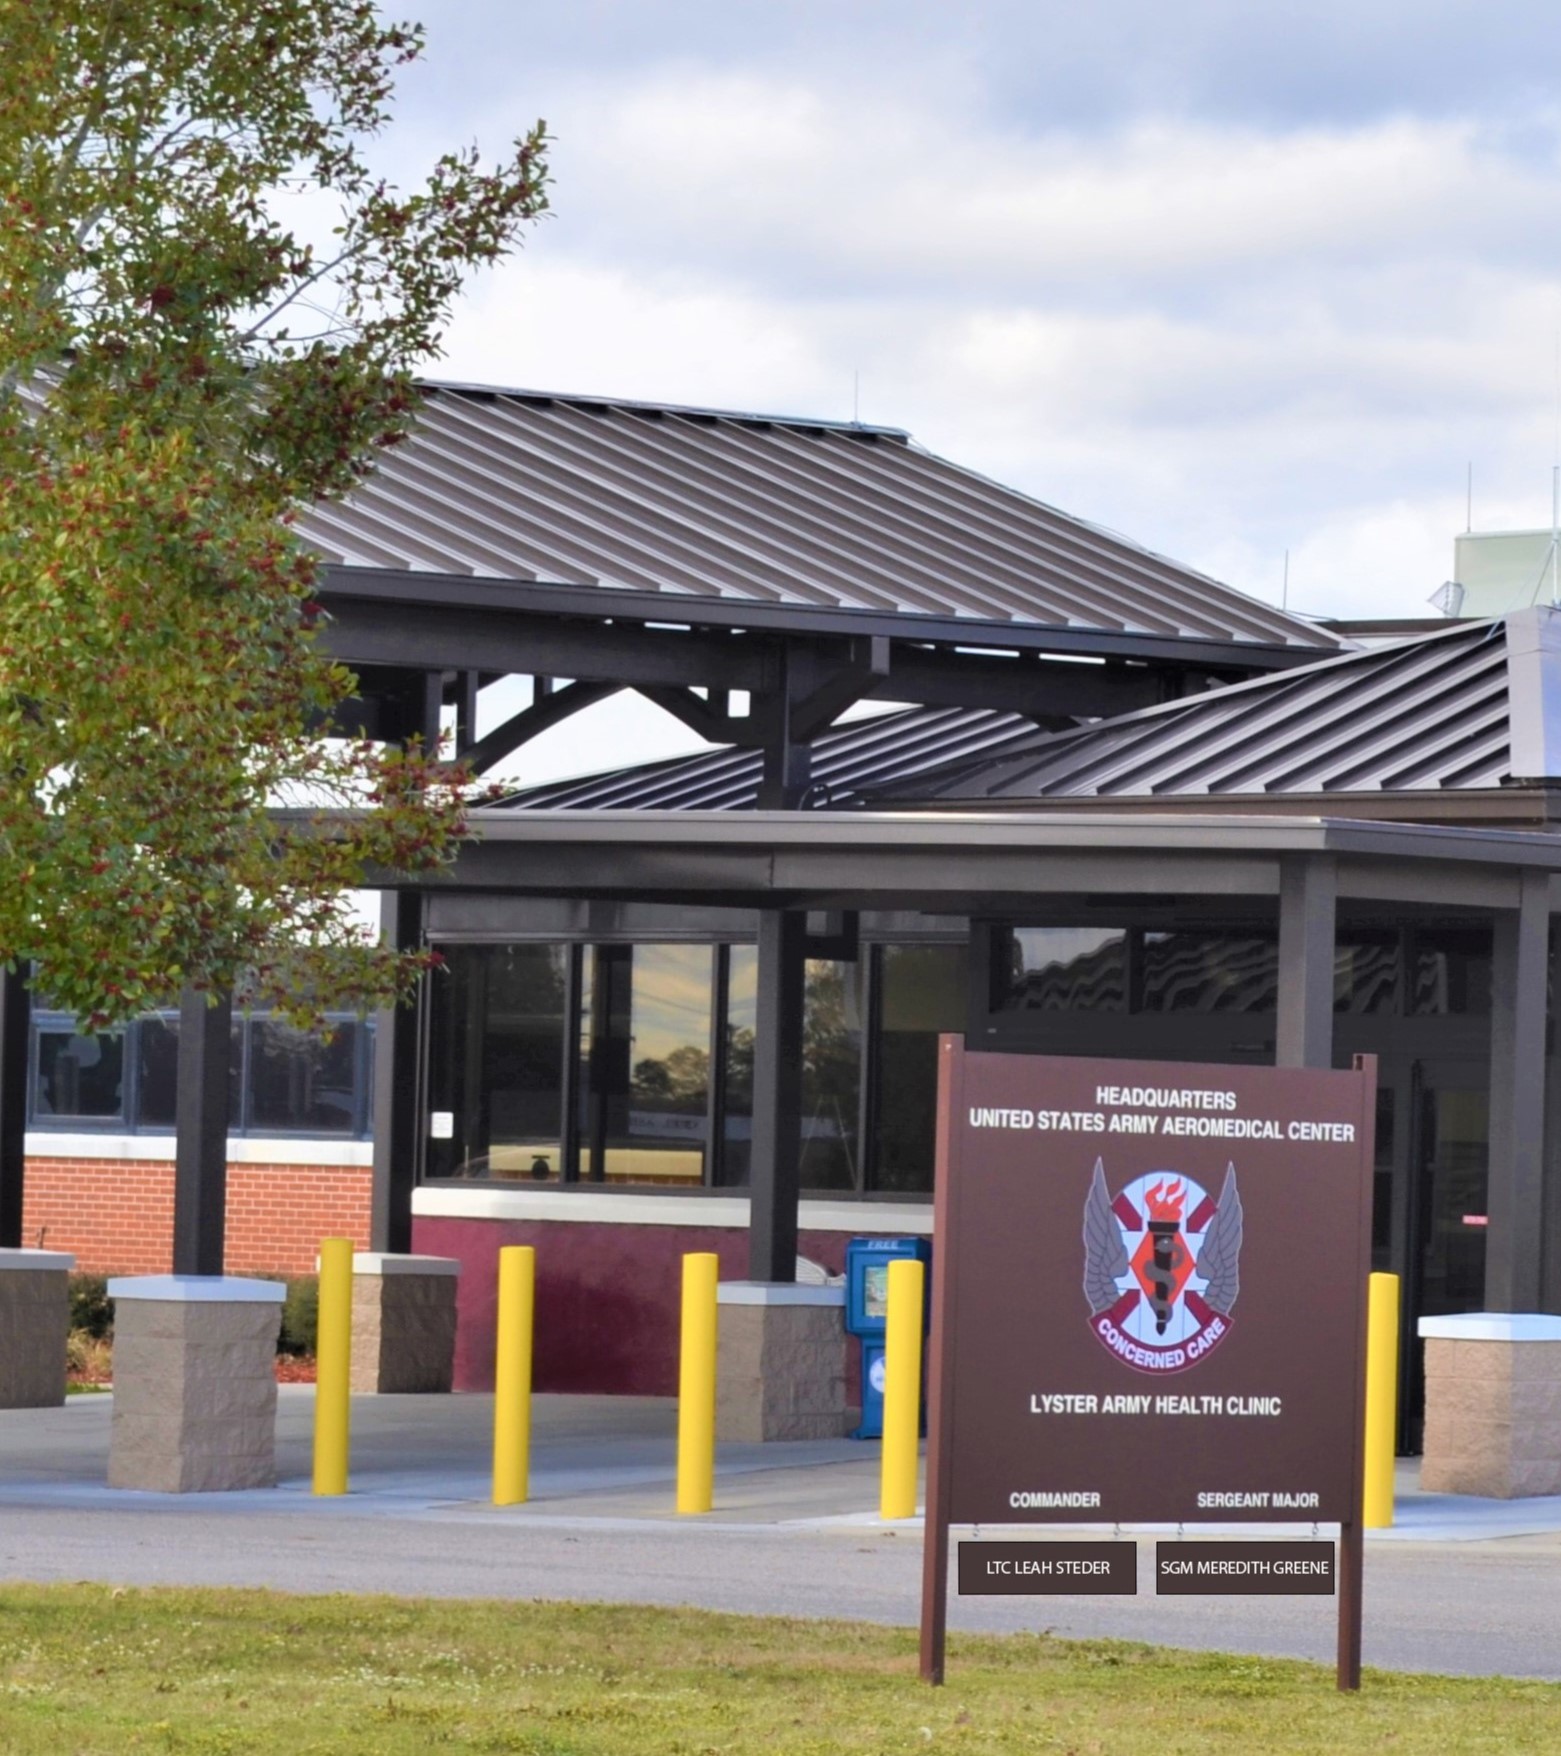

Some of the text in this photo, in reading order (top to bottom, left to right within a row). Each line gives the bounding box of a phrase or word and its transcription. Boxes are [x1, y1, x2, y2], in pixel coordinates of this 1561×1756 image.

[1096, 1086, 1237, 1110] HEADQUARTERS
[969, 1108, 1355, 1142] UNITED STATES ARMY AEROMEDICAL CENTER
[867, 1240, 899, 1250] FREE
[1098, 1317, 1225, 1369] CONCERNED CARE
[1030, 1394, 1282, 1416] LYSTER ARMY HEALTH CLINIC
[1009, 1491, 1101, 1509] COMMANDER
[1197, 1491, 1320, 1508] SERGEANT MAJOR
